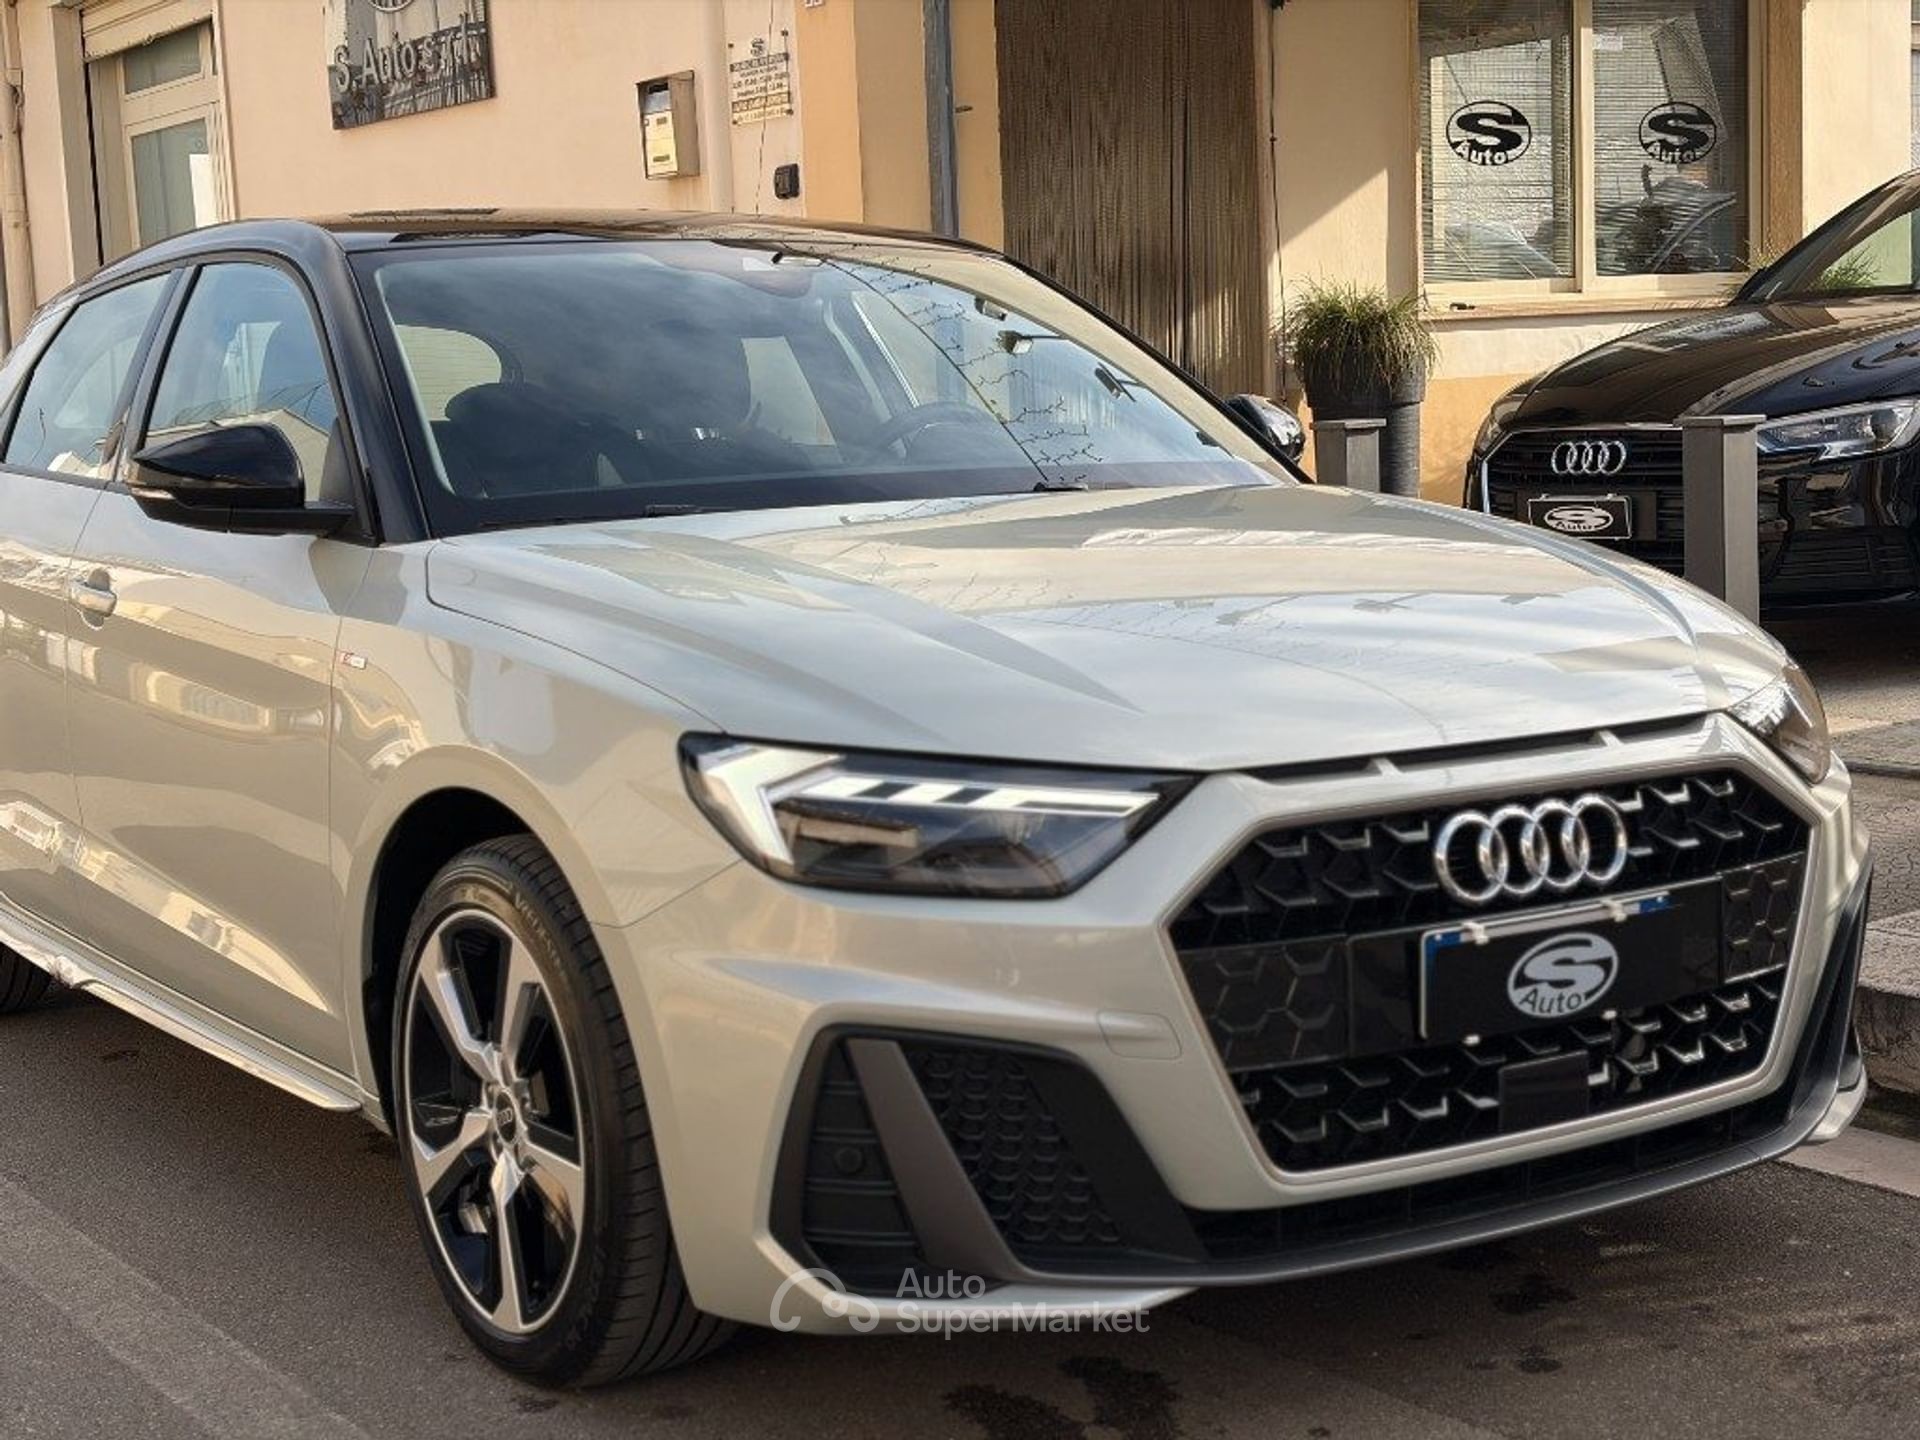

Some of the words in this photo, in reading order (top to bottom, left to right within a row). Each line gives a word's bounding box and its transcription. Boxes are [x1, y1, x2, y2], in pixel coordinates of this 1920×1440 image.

[361, 36, 416, 84] Auto
[1457, 112, 1529, 152] S
[1648, 112, 1715, 152] S
[1649, 140, 1698, 164] Auto
[1456, 140, 1508, 165] Auto
[1523, 938, 1612, 992] S
[1519, 988, 1583, 1014] Auto
